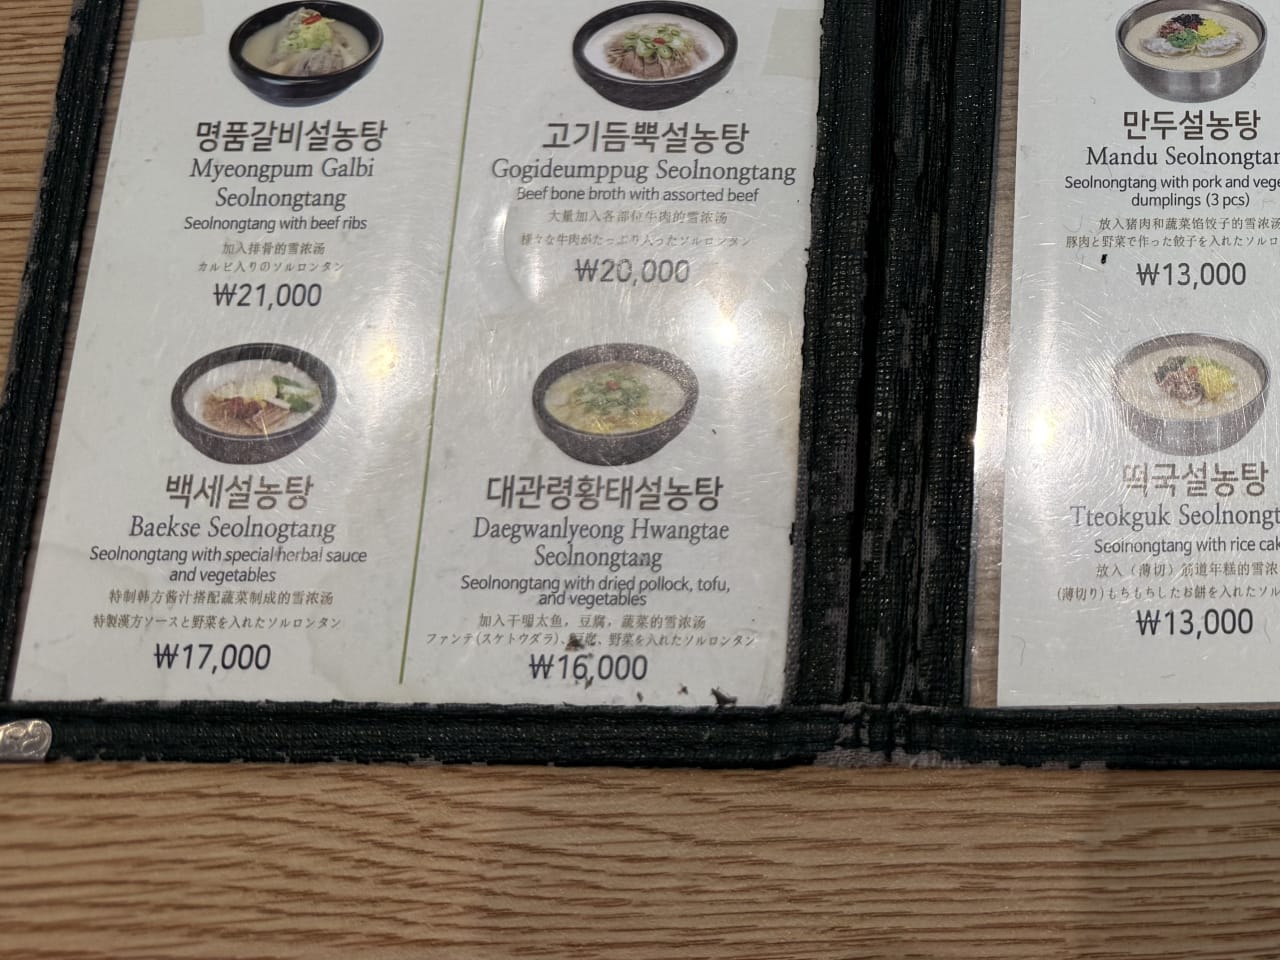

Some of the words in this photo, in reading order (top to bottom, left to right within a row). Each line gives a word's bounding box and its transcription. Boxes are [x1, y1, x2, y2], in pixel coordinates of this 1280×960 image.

[196, 119, 388, 153] 명품갈비설농탕
[541, 120, 750, 155] 고기듬뿍설농탕
[1123, 109, 1261, 141] 만두설농탕
[189, 157, 314, 184] Myeongpum
[320, 156, 375, 178] Galbi
[1085, 144, 1159, 166] Mandu
[491, 157, 650, 185] Gogideumppug
[655, 158, 797, 186] Seolnongtang
[215, 185, 348, 213] Seolnongtang
[165, 473, 315, 511] 백세설농탕
[486, 474, 724, 512] 대관령황태설농탕
[128, 514, 201, 538] Baekse
[207, 514, 337, 545] Seolnogtang
[472, 515, 625, 546] Daegwanlyeong
[629, 517, 730, 546] Hwangtae
[1069, 502, 1172, 533] Tteokguk
[535, 543, 663, 573] Seolnongtang
